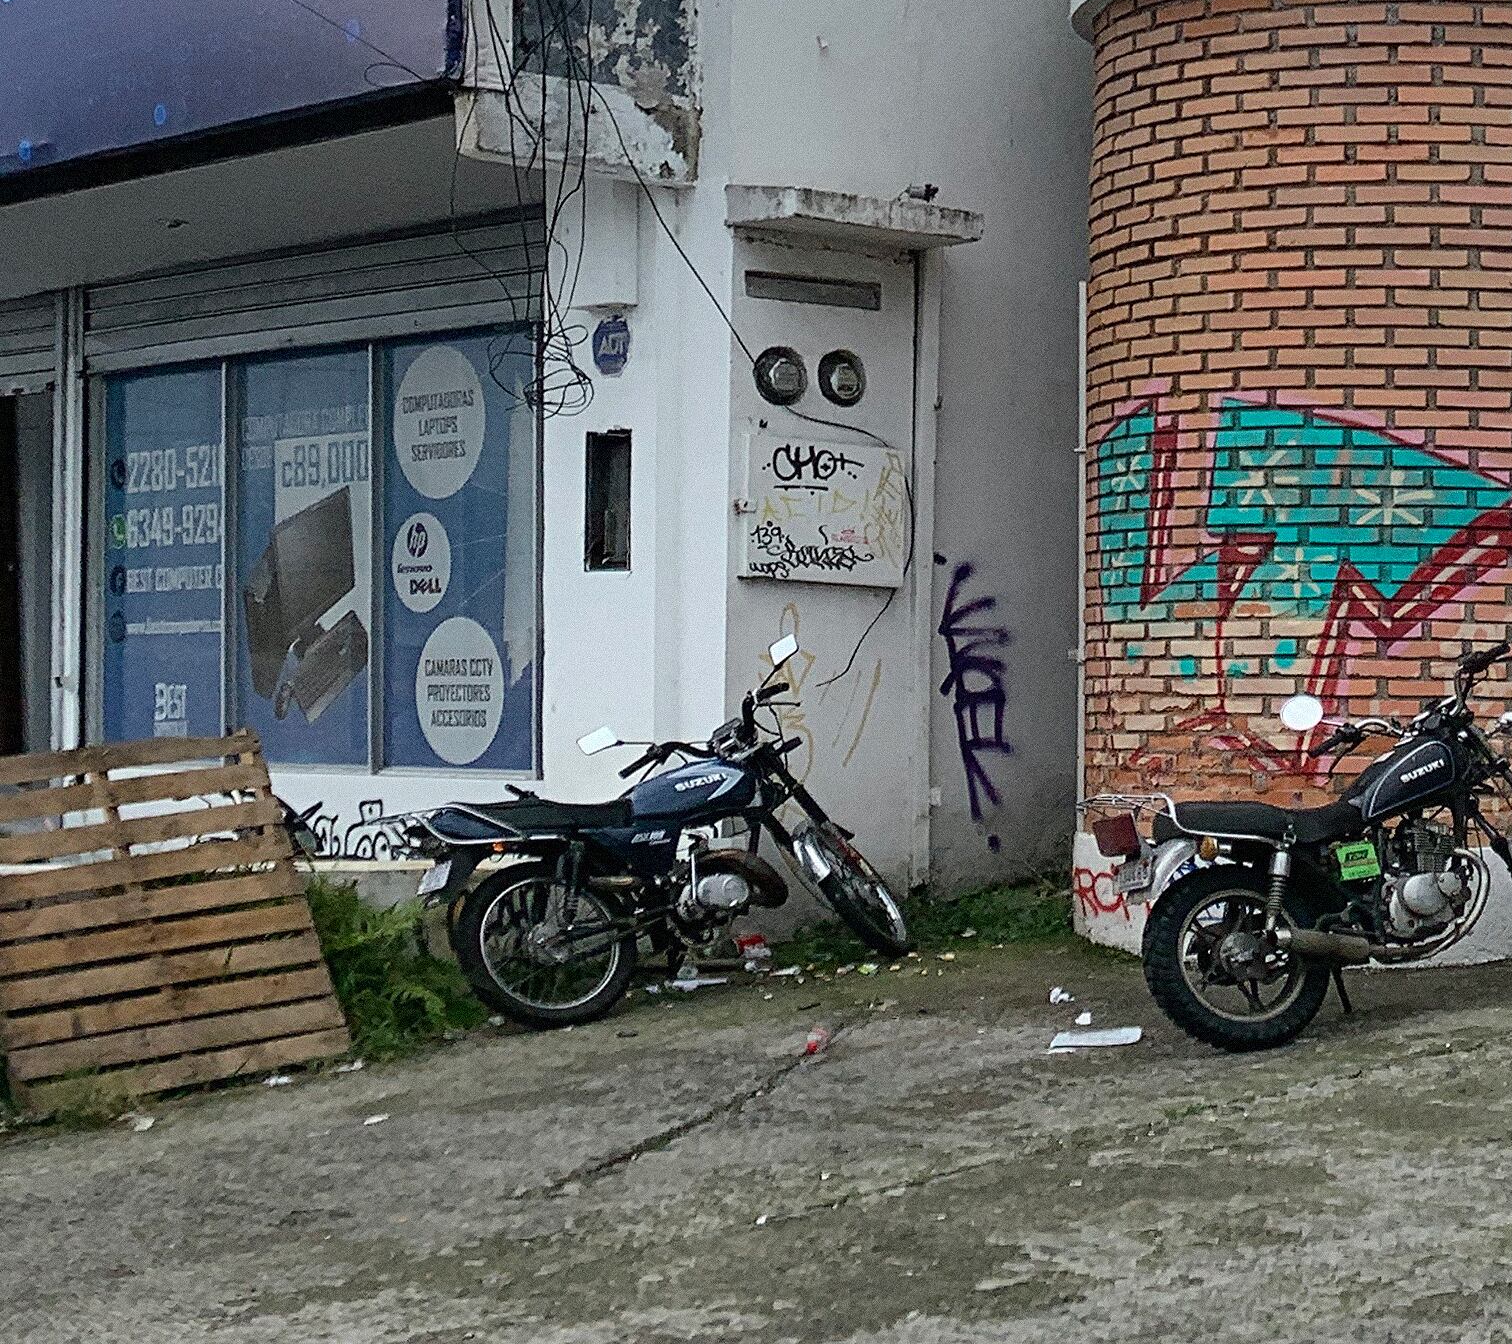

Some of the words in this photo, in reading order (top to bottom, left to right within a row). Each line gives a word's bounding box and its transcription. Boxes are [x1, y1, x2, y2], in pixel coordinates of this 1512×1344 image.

[127, 445, 223, 493] 2280-521
[127, 503, 223, 548] 6349-929
[410, 577, 442, 595] DELL
[674, 772, 727, 792] SUZUKI
[1400, 758, 1445, 784] SUZUKI
